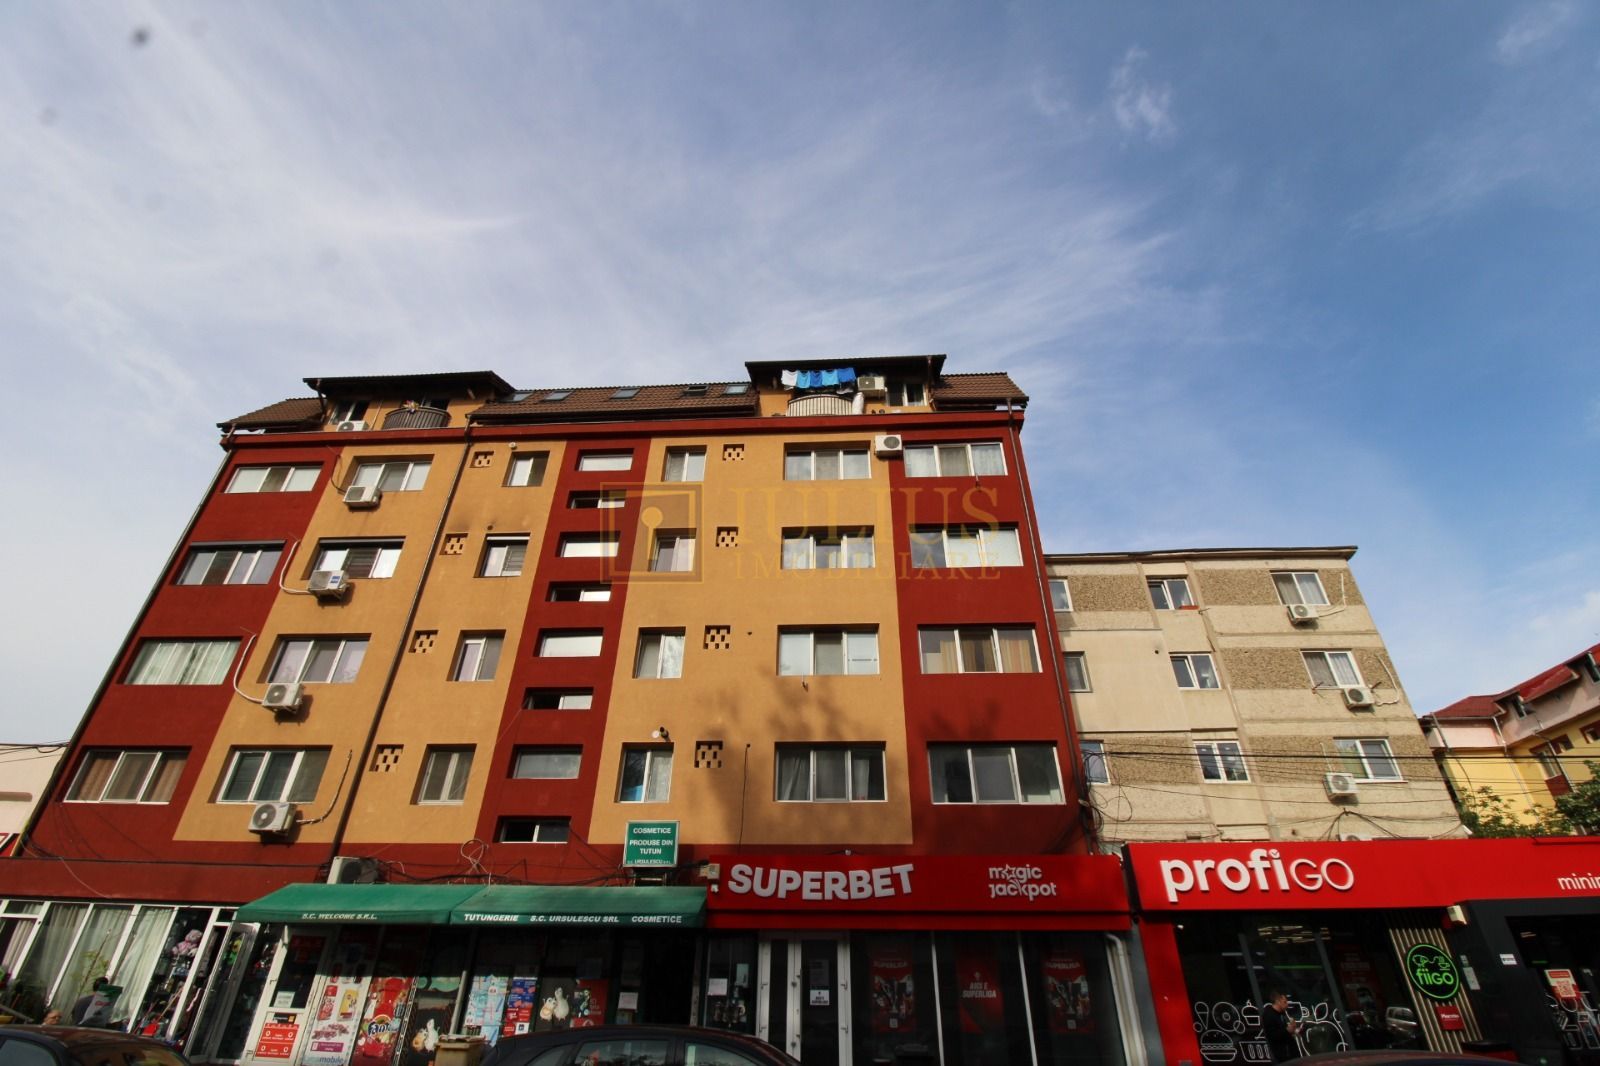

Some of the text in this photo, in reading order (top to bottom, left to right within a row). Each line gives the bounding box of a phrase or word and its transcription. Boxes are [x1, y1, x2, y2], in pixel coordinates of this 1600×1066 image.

[728, 863, 914, 901] SUPERBET
[988, 863, 1042, 883] magic
[988, 879, 1057, 901] jackpot
[464, 913, 519, 922] TUTUNGERIE
[549, 915, 601, 923] URSULESCU
